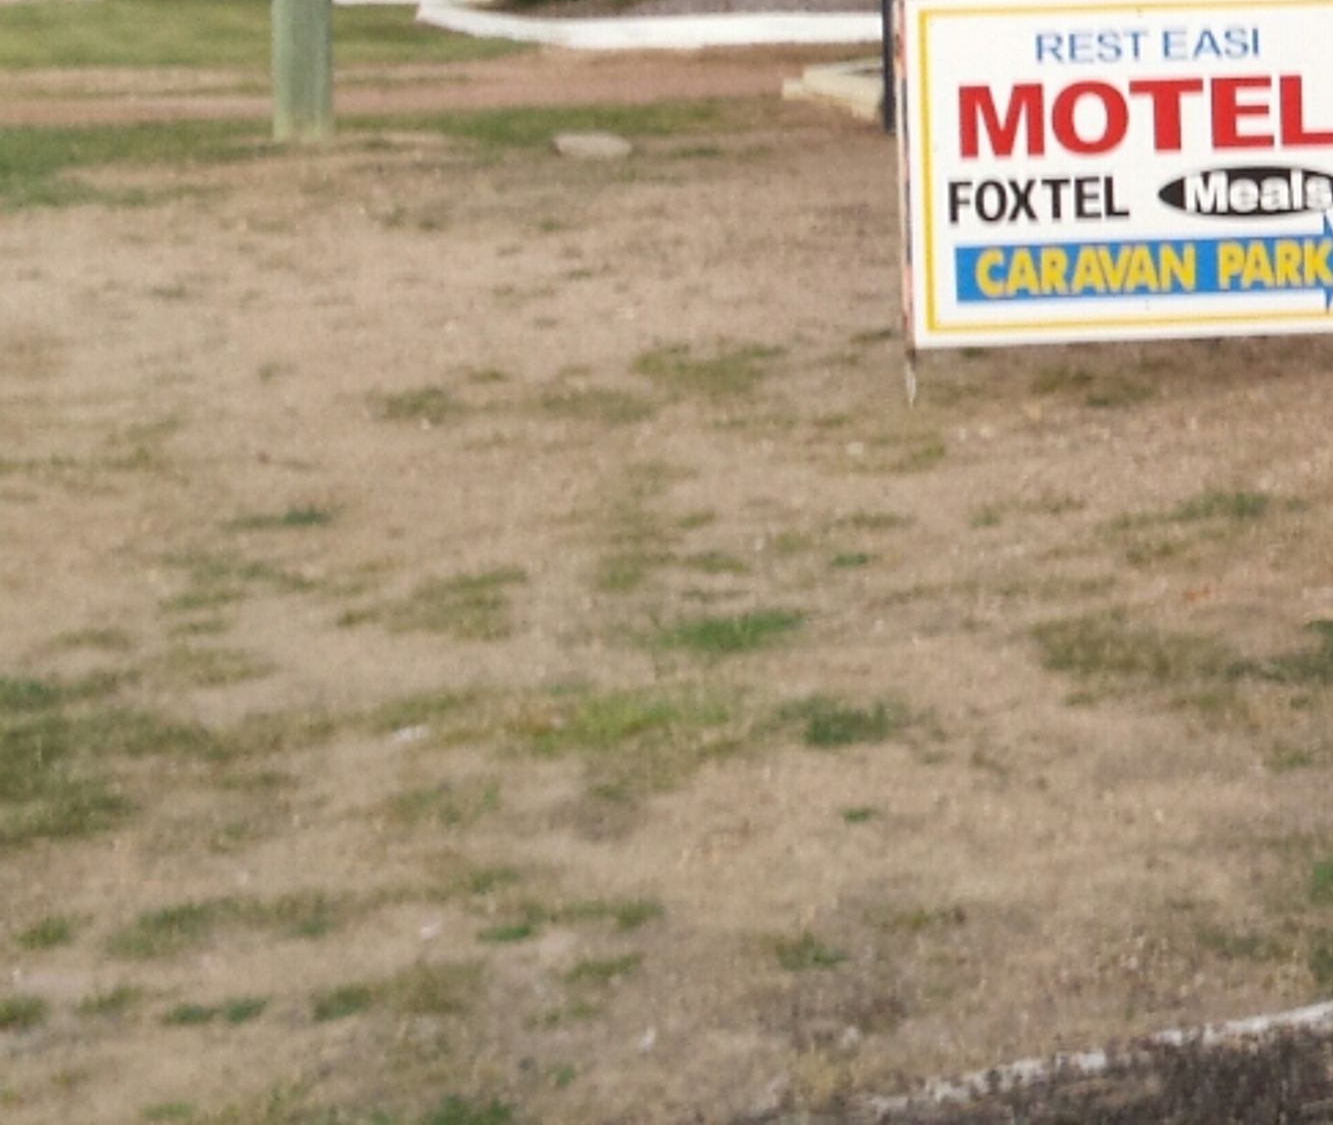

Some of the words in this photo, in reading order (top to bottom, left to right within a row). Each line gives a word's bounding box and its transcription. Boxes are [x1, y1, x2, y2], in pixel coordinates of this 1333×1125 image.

[1035, 30, 1149, 64] REST
[1162, 27, 1261, 59] EASI
[947, 176, 1131, 225] FOXTEL
[975, 242, 1197, 298] CARAVAN
